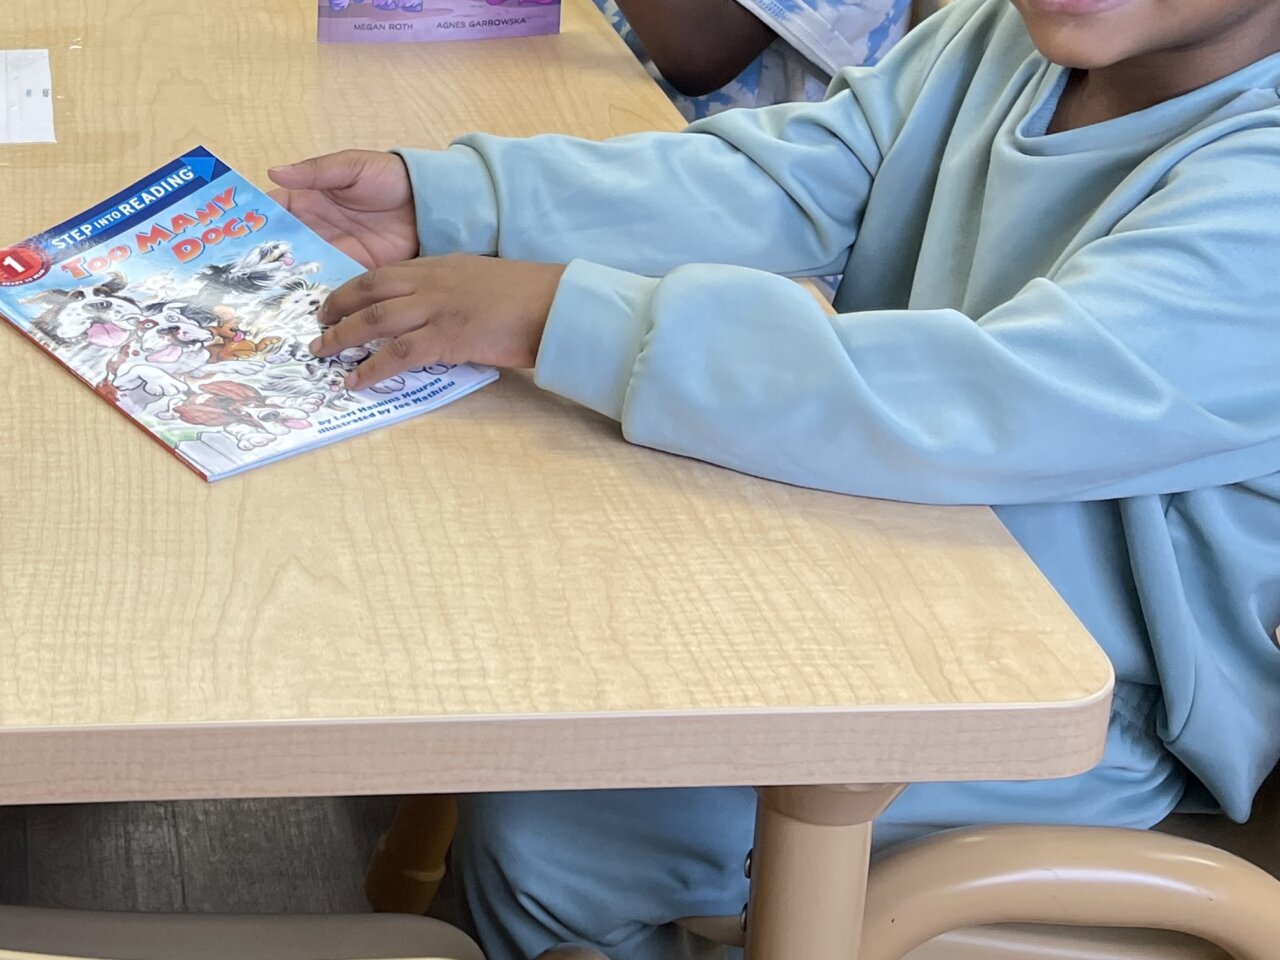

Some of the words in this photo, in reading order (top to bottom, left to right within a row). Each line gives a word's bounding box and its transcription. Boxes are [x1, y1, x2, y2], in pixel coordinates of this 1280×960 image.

[436, 21, 465, 29] AGNES
[468, 17, 527, 28] GARBOWSKA
[52, 224, 93, 250] STEP
[94, 210, 122, 229] INTO
[119, 168, 194, 217] READING
[60, 244, 131, 280] TOO
[134, 186, 239, 254] MANY
[171, 209, 269, 263] DOGS
[3, 256, 26, 273] 1
[317, 418, 331, 426] by
[334, 410, 356, 421] Lori
[357, 396, 400, 414] Haskins
[377, 408, 392, 416] by
[411, 380, 456, 405] Mathieu
